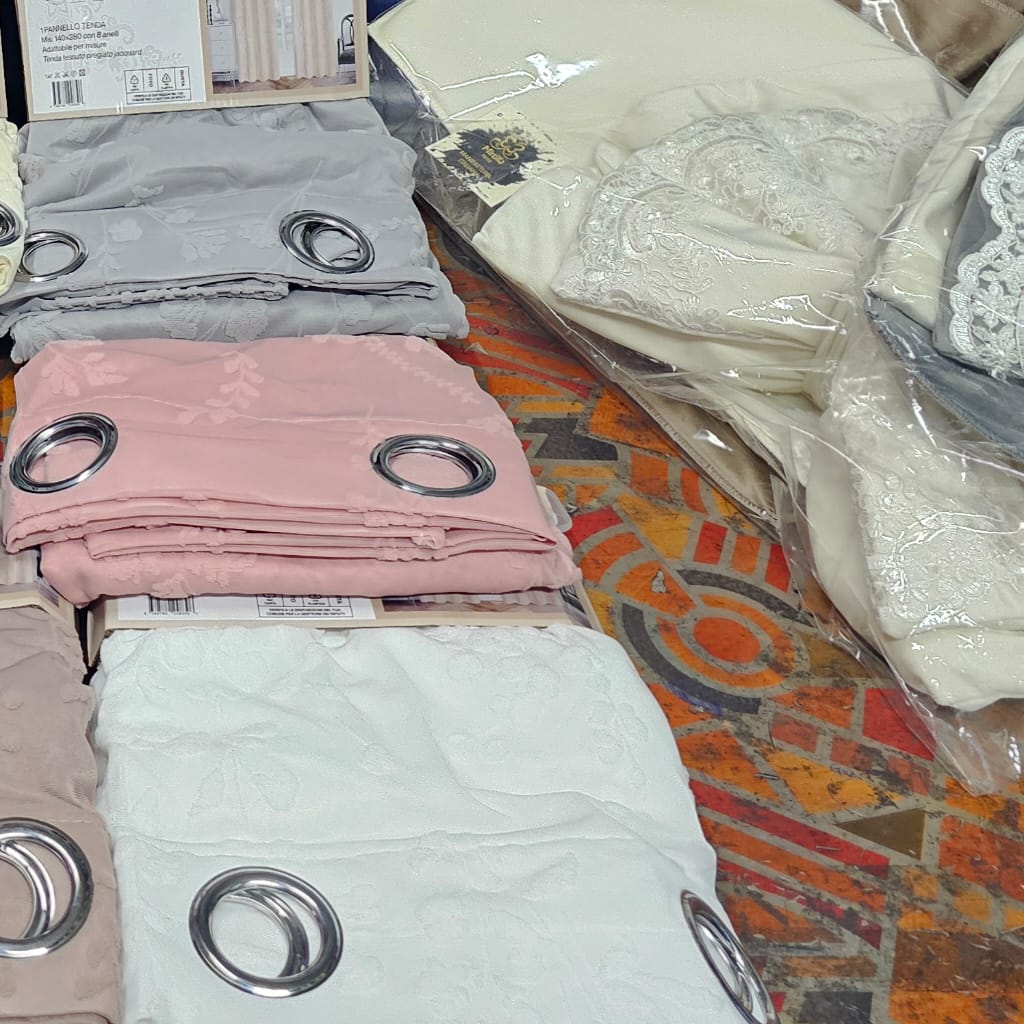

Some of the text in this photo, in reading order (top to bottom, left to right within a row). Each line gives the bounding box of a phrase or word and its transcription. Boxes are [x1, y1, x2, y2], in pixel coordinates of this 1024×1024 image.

[44, 23, 80, 33] PANNELLO
[43, 45, 72, 53] Adattabile
[87, 51, 112, 61] pregiato
